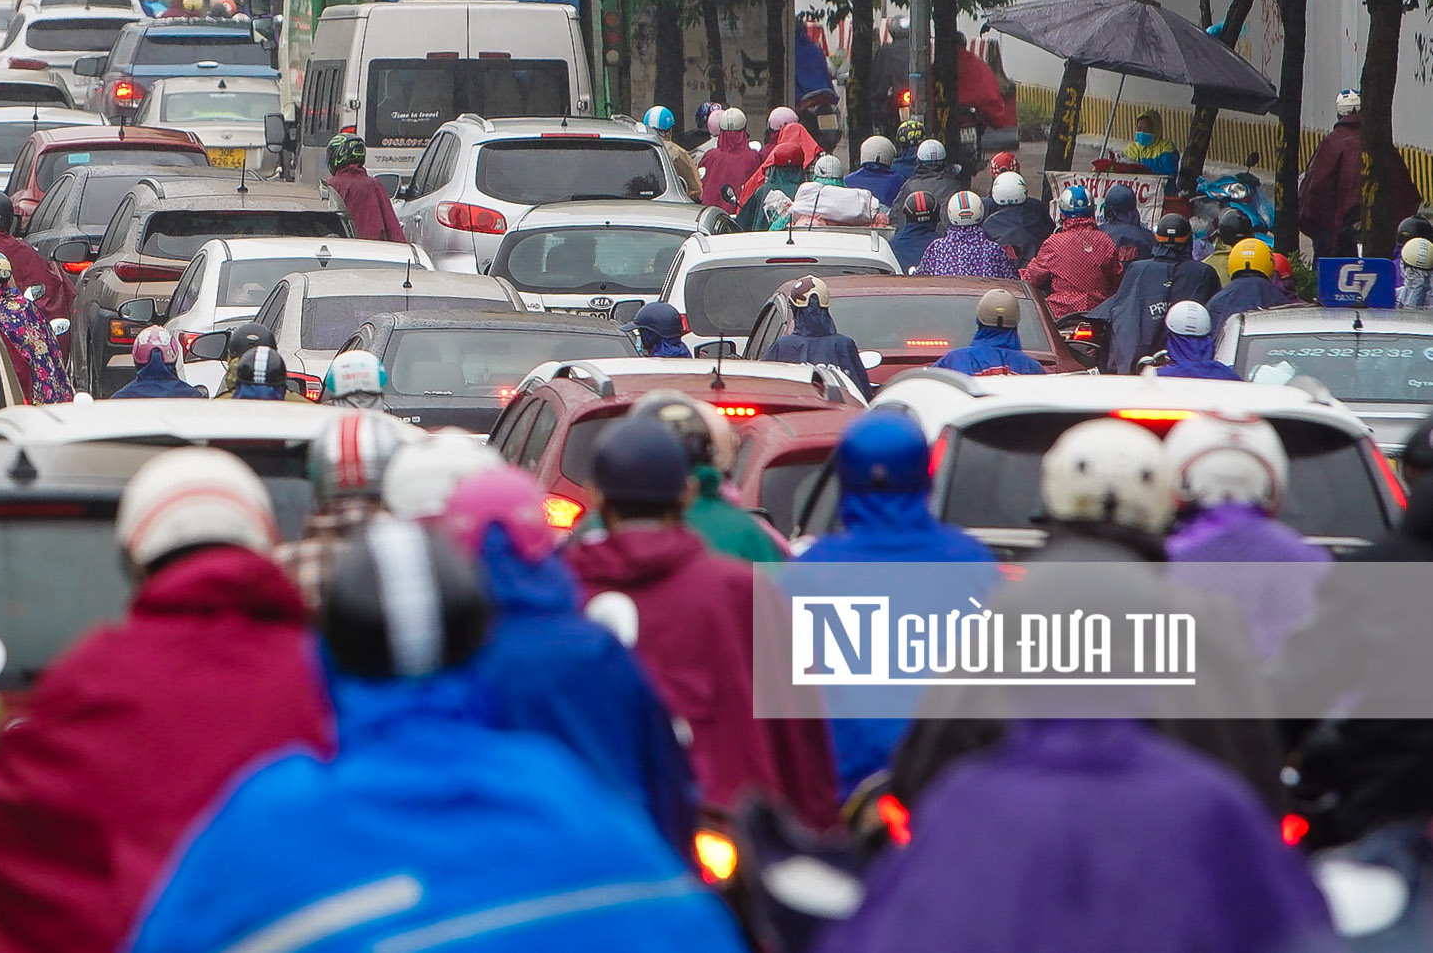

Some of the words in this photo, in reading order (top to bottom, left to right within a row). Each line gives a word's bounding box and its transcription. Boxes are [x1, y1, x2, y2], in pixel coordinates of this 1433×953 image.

[593, 298, 611, 306] KIA
[1327, 348, 1356, 358] 32
[1357, 348, 1384, 358] 32
[1387, 349, 1414, 358] 32
